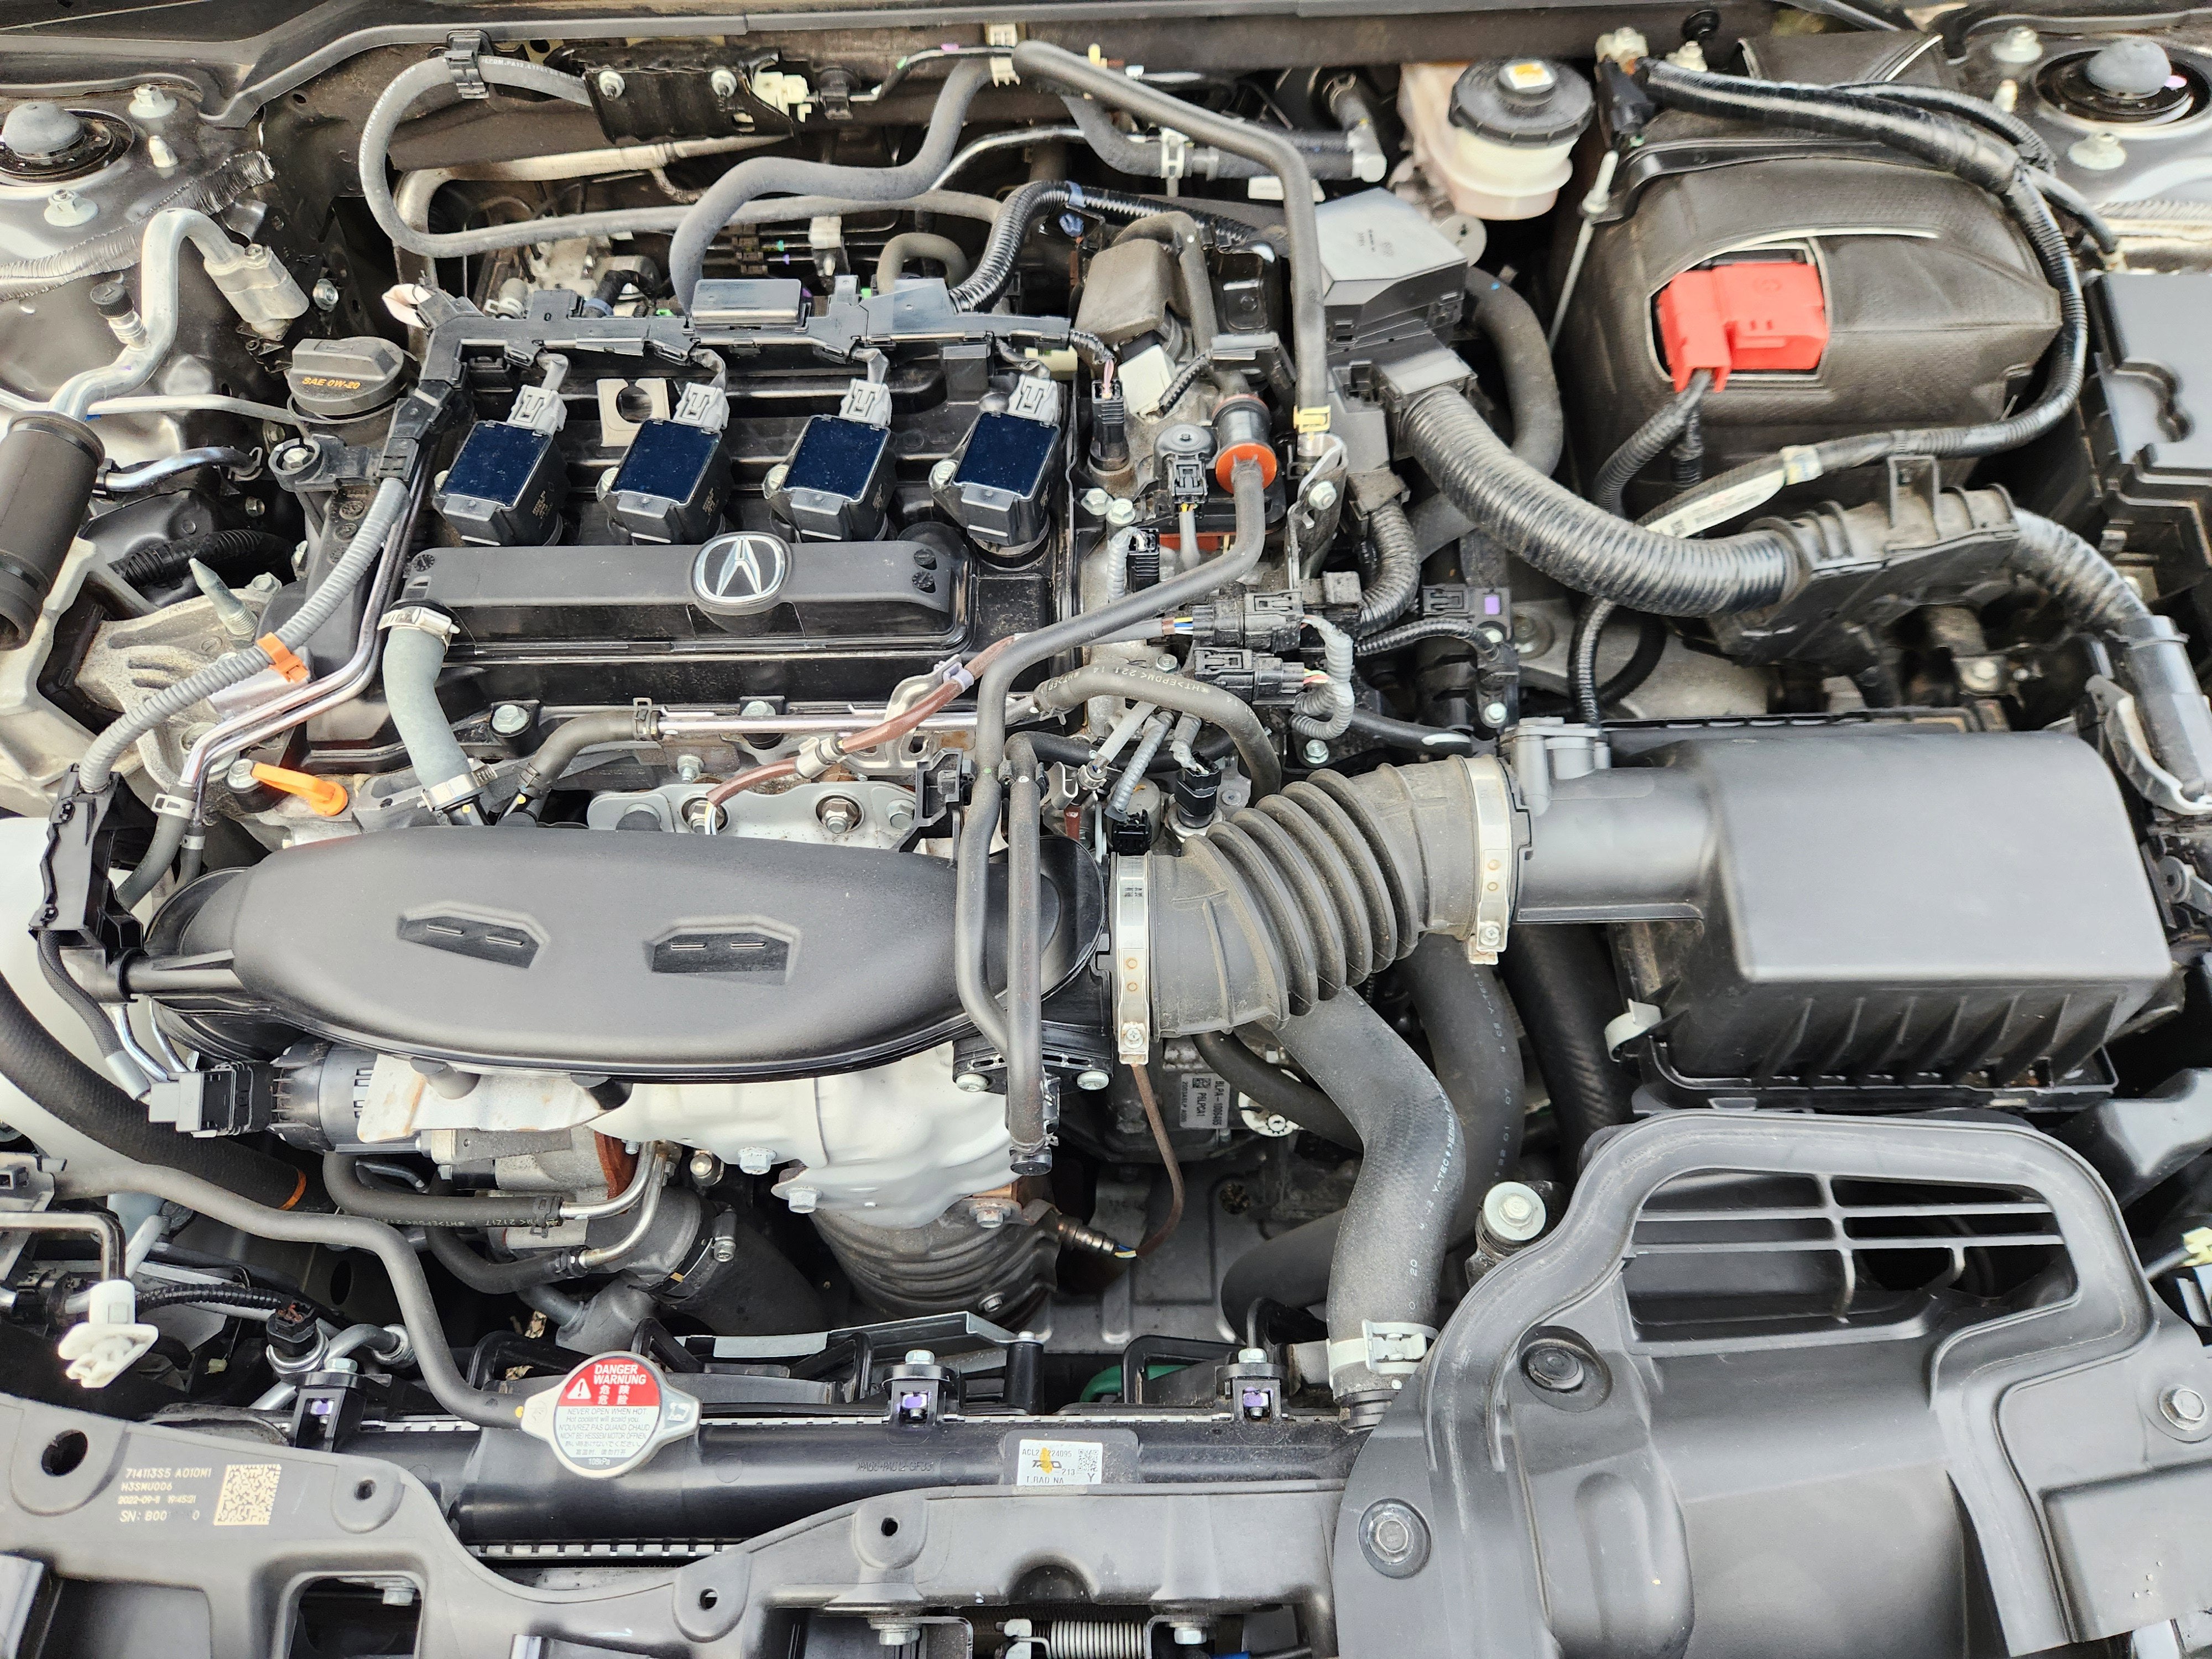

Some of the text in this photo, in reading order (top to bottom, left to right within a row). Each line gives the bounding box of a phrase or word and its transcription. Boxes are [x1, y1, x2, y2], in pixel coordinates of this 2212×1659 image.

[301, 377, 361, 389] SAE 0W-20
[594, 1364, 639, 1374] DANGER
[593, 1374, 646, 1385] WARNUNG
[1087, 1473, 1095, 1483] Y
